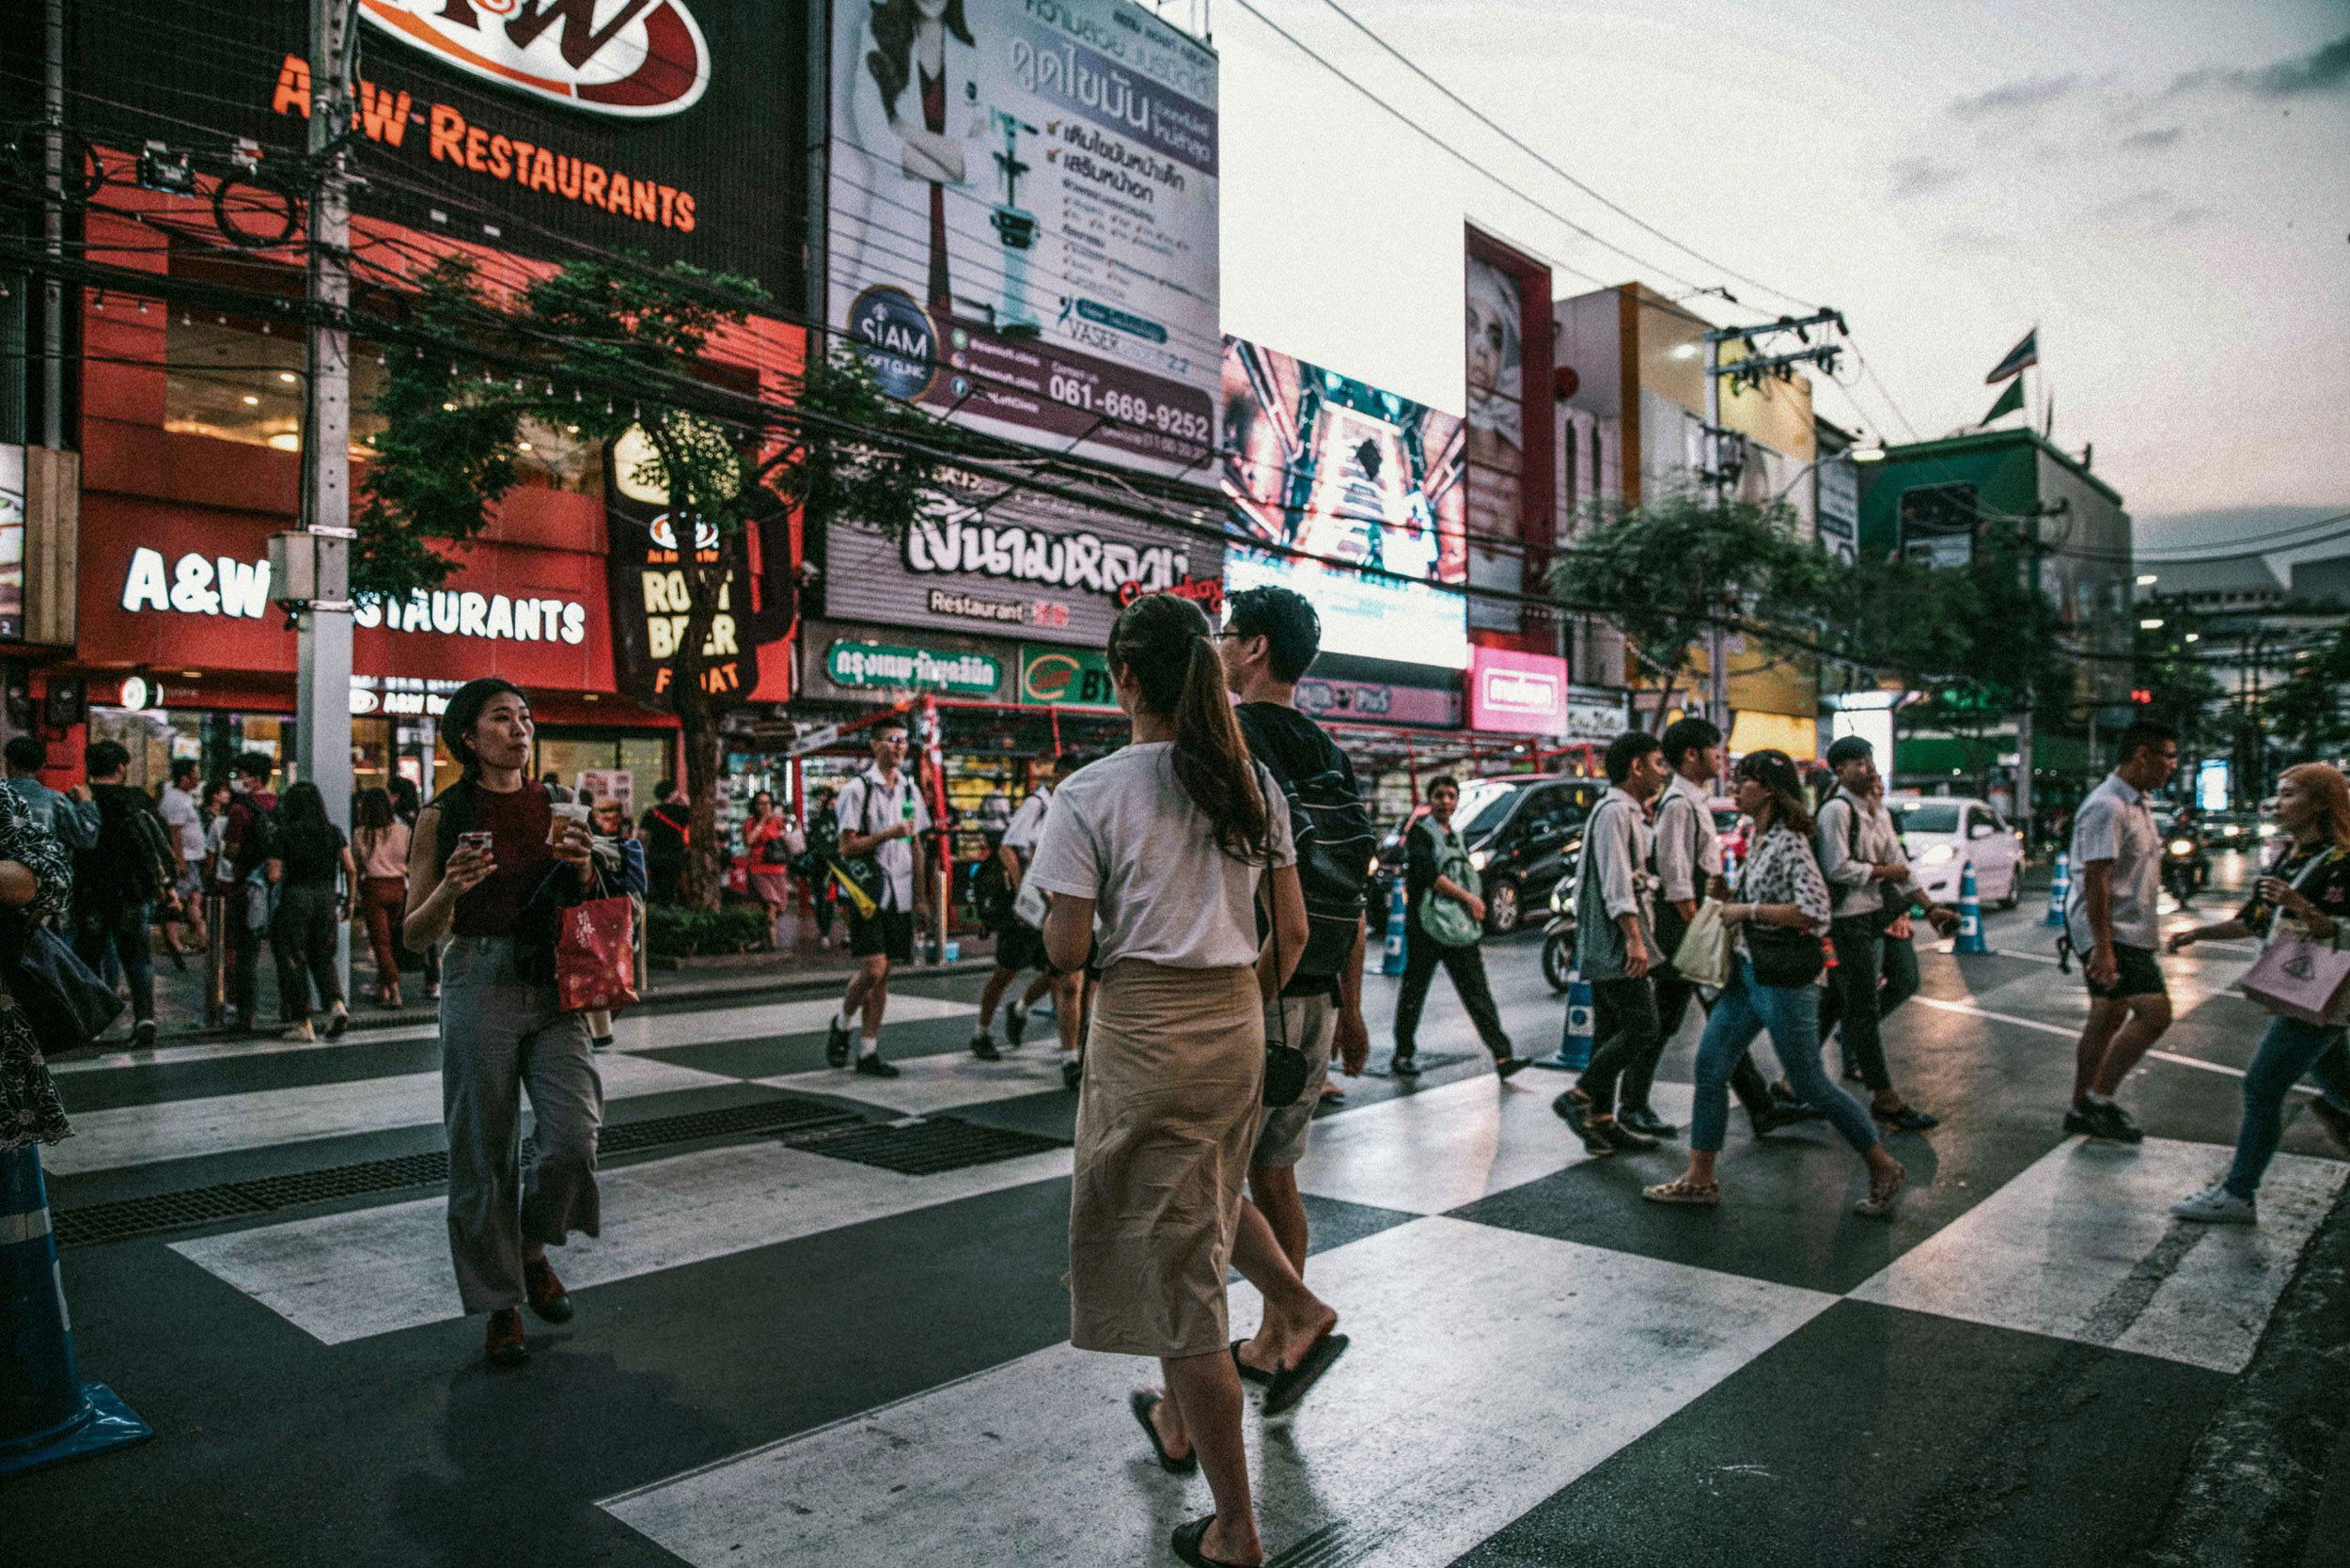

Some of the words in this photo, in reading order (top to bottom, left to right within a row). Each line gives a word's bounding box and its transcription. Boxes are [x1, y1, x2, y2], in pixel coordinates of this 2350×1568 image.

[272, 53, 697, 232] AW-RESTAURANTS
[1049, 374, 1210, 442] 061-669-9252
[121, 546, 272, 619] A&W
[930, 589, 1024, 624] Restaurant
[654, 661, 741, 695] FAT
